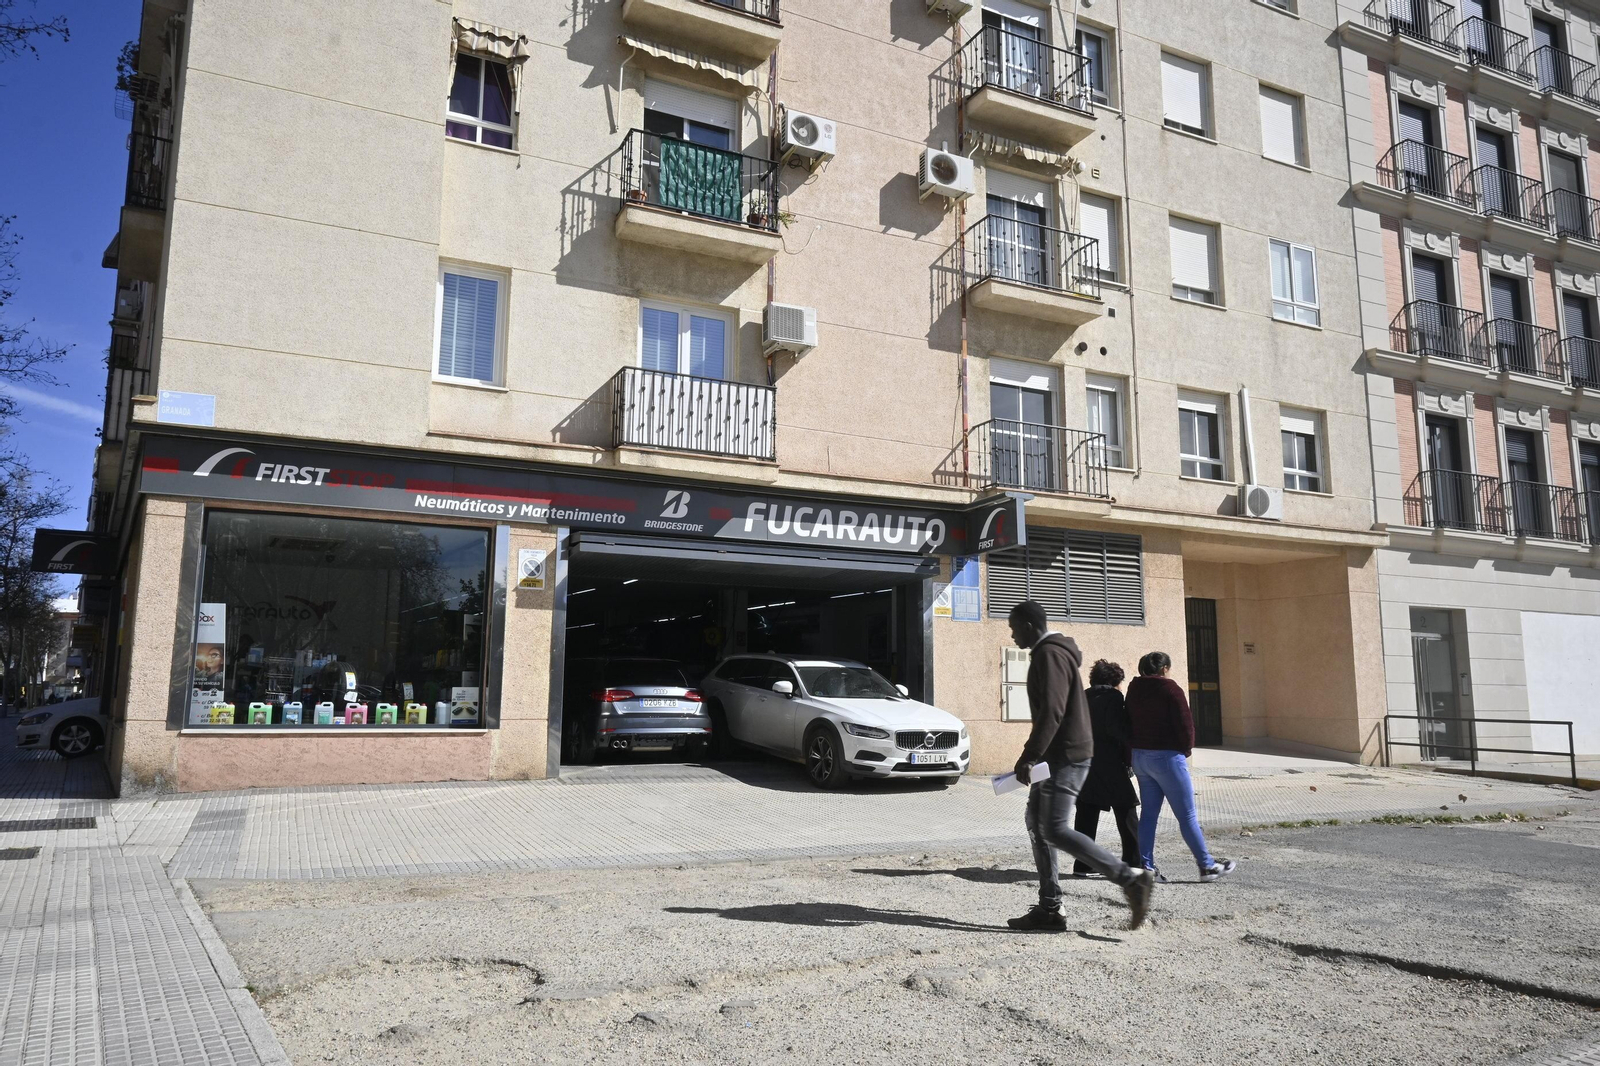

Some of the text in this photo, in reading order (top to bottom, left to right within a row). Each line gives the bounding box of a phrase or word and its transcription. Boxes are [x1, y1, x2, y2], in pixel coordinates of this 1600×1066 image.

[161, 405, 191, 416] GRANADA
[414, 494, 627, 525] Neumáticos y Mantenimiento
[644, 519, 704, 533] BRIDGESTONE
[743, 501, 946, 549] FUCARAUTO
[978, 538, 995, 550] FIRST
[47, 562, 75, 571] FIRST
[1420, 615, 1427, 628] 2
[644, 699, 662, 707] 0206
[916, 755, 948, 763] 1051 LXV
